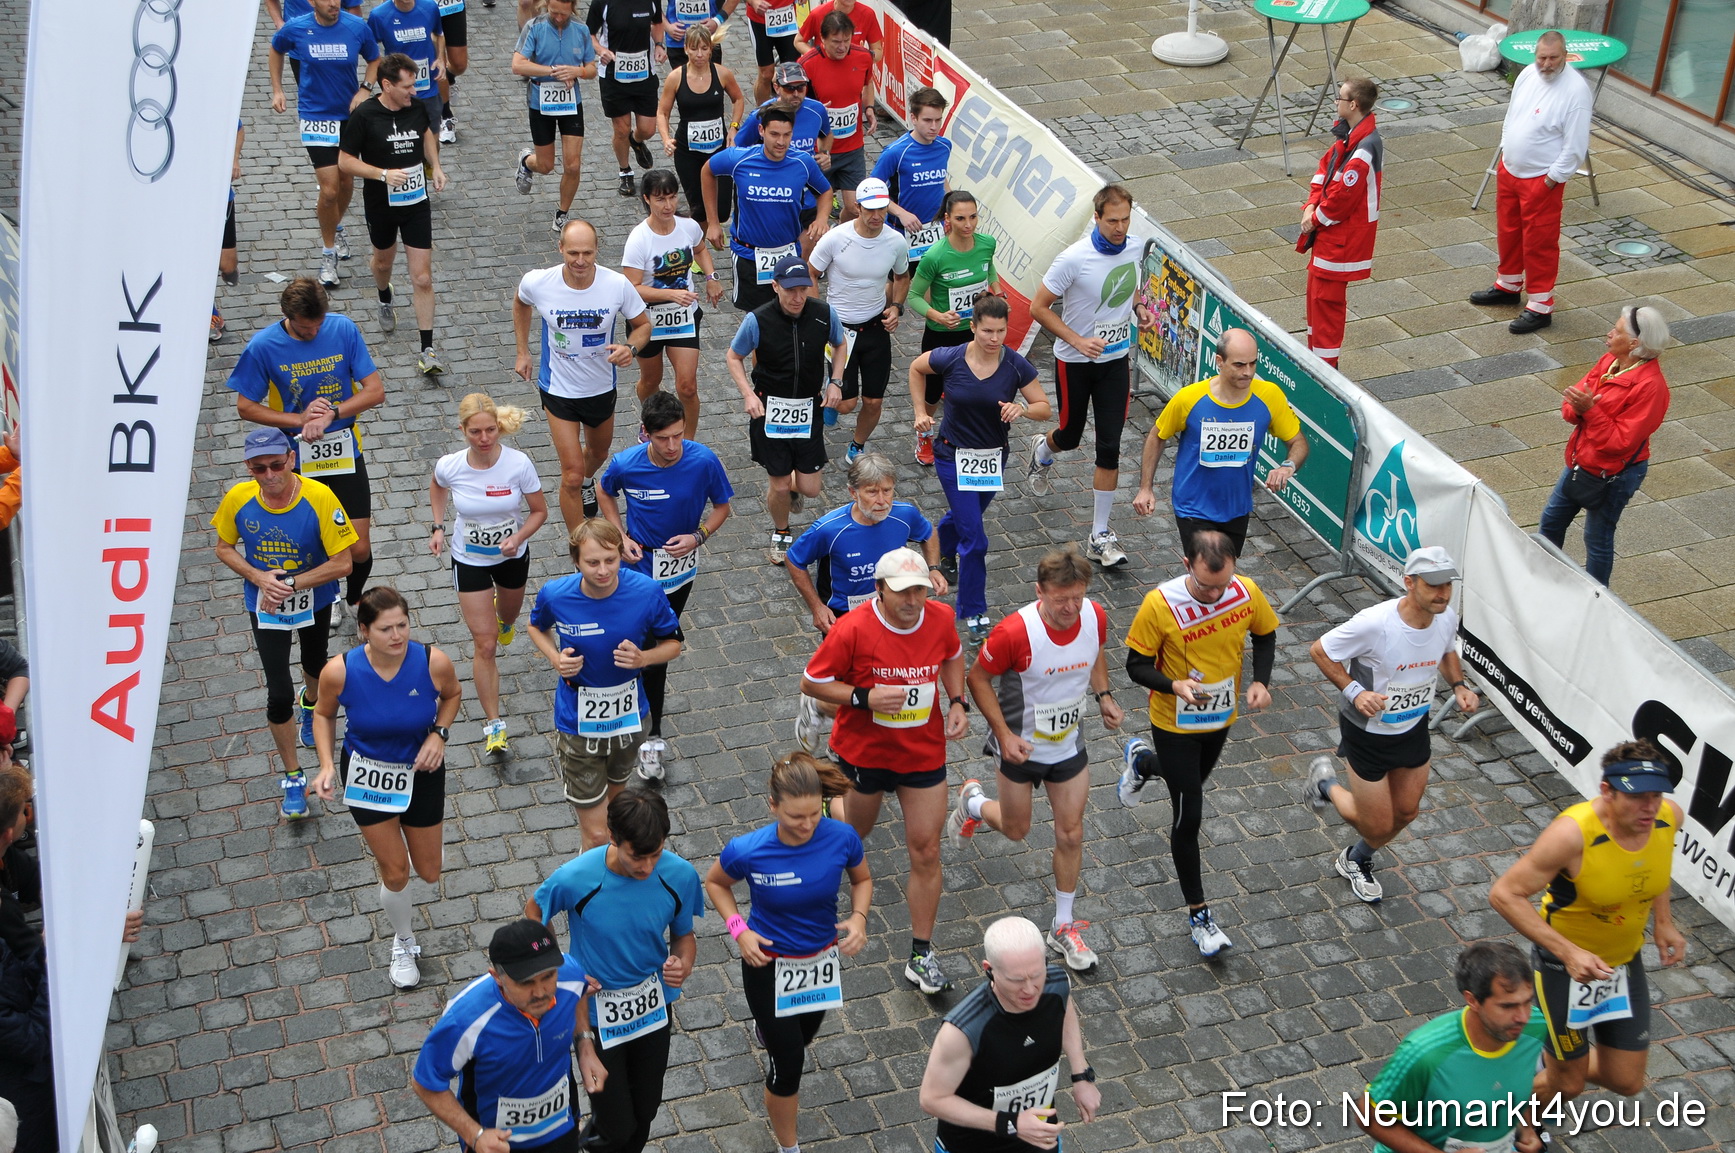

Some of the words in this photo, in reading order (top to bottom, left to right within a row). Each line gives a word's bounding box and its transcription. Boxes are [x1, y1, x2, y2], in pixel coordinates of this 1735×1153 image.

[679, 2, 707, 14] 2544
[768, 12, 793, 26] 2349
[394, 26, 426, 38] HUBER
[308, 44, 348, 54] HUBER
[618, 59, 646, 72] 2683
[544, 90, 572, 102] 2201
[304, 120, 337, 134] 2856
[829, 113, 856, 128] 2402
[692, 126, 721, 142] 2403
[394, 141, 414, 150] Berlin
[790, 138, 814, 148] SCAD
[912, 169, 947, 182] SYSCAD
[748, 186, 793, 198] SYSCAD
[910, 229, 942, 247] 2431
[760, 253, 793, 271] 24
[656, 309, 689, 326] 2061
[1099, 324, 1128, 344] 2226
[279, 364, 291, 372] 10.
[291, 354, 344, 370] NEUMARKTER
[290, 364, 336, 378] STADTLAUF
[1258, 348, 1296, 392] it-Systeme
[108, 269, 164, 474] BKK
[771, 408, 808, 424] 2295
[1206, 434, 1249, 450] 2826
[311, 442, 343, 460] 339
[316, 462, 340, 470] Hubert
[960, 458, 998, 474] 2296
[966, 478, 994, 486] Stephanie
[1255, 460, 1267, 477] ne:
[1292, 492, 1311, 516] 6352
[338, 526, 350, 536] PAR
[470, 528, 514, 546] 3322
[659, 554, 696, 578] 2273
[1357, 538, 1386, 566] Gebäude
[1388, 560, 1405, 578] Servi
[850, 563, 875, 576] SYS
[278, 616, 294, 624] Karl
[1182, 623, 1218, 644] MAX
[1220, 606, 1255, 629] BÖGL
[89, 518, 152, 744] Audi
[872, 665, 931, 679] NEUMARKT
[602, 688, 629, 698] Neumarkt
[1390, 687, 1431, 712] 2352
[586, 694, 633, 719] 2218
[596, 720, 623, 732] Philipp
[1048, 708, 1080, 732] 198
[1194, 714, 1220, 724] Stefan
[1508, 684, 1523, 704] die
[1526, 698, 1575, 755] verbinden
[352, 756, 373, 766] PARTL
[374, 761, 404, 770] Neumarkt
[354, 766, 408, 791] 2066
[362, 792, 392, 804] Andrea
[782, 962, 834, 992] 2219
[622, 982, 650, 998] Neumarkt
[604, 987, 659, 1024] 3388
[790, 992, 826, 1006] Rebecca
[606, 1018, 648, 1038] MANUEL
[996, 1088, 1020, 1099] PARTL
[1008, 1082, 1049, 1113] 657
[500, 1100, 527, 1109] PARTL
[505, 1092, 564, 1127] 3500
